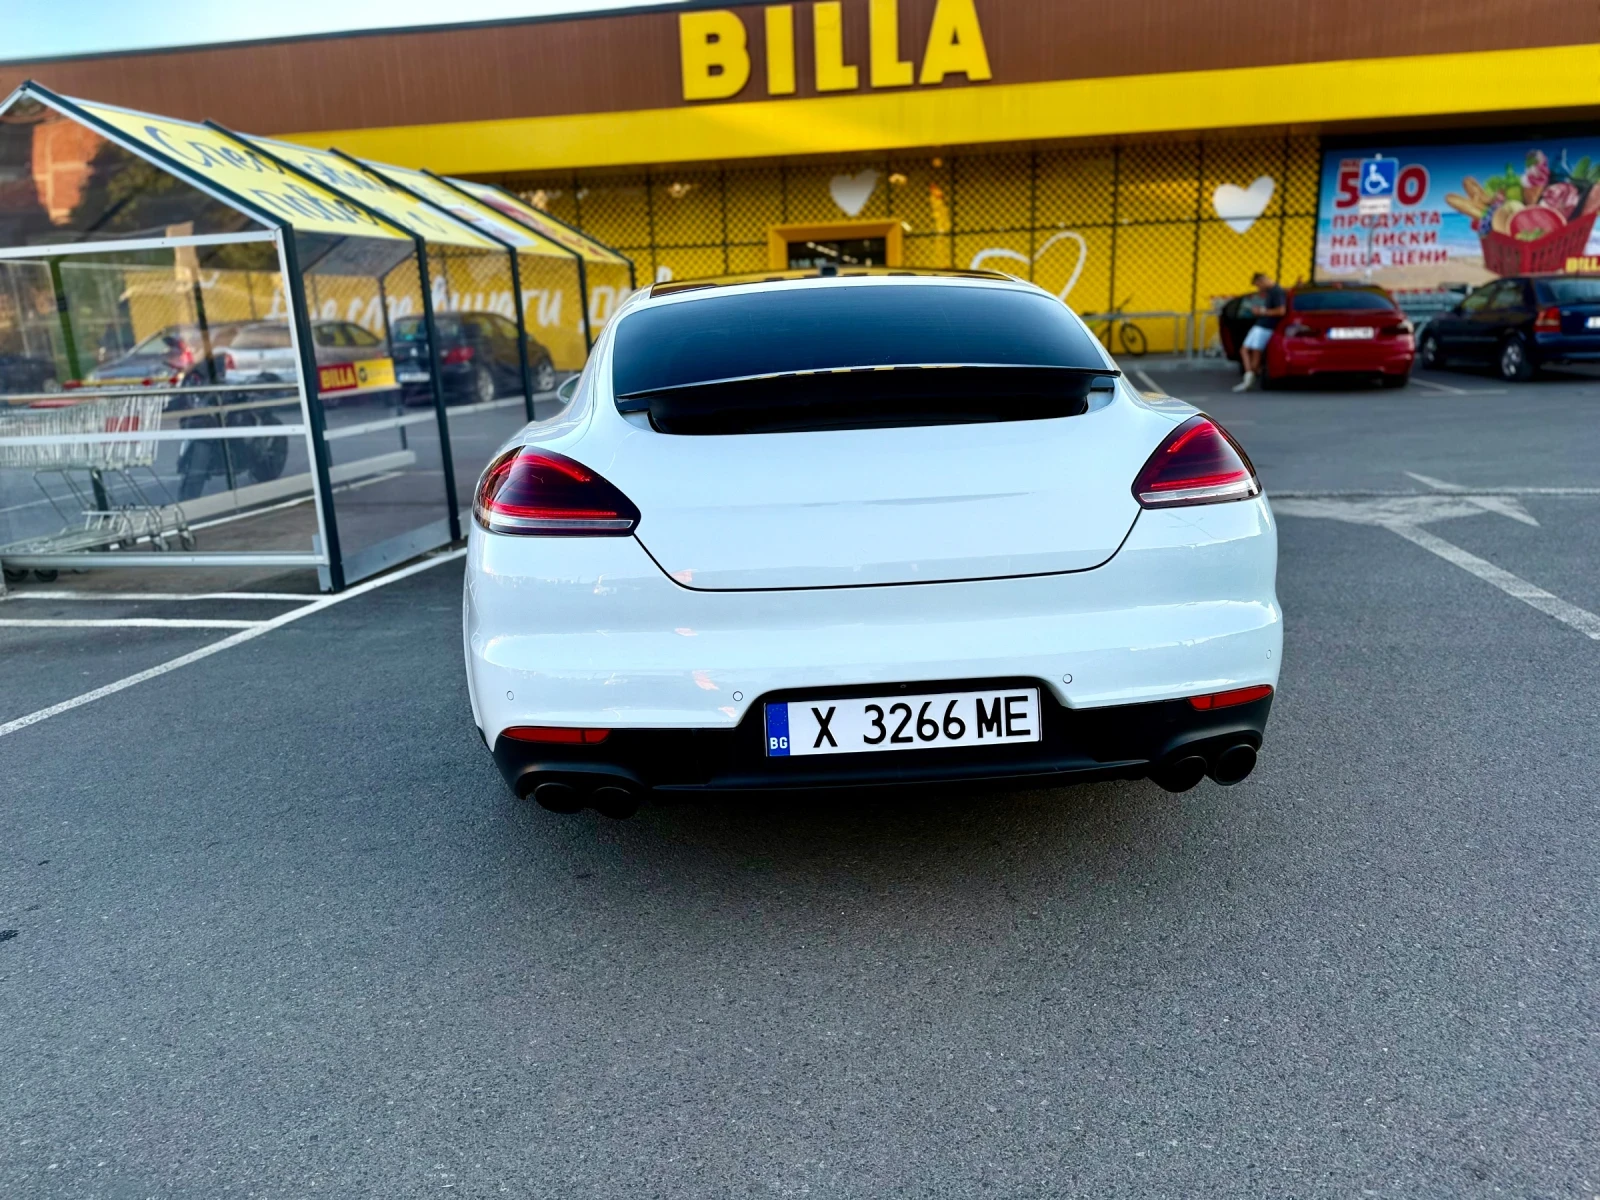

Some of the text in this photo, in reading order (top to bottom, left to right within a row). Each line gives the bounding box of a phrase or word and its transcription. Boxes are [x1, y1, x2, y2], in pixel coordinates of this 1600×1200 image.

[680, 0, 993, 101] BILLA
[1334, 165, 1429, 209] 50
[1333, 211, 1441, 229] ПРОДУКТА
[1331, 233, 1359, 248] НА
[1330, 249, 1448, 268] BILLA ЦЕНИ
[321, 367, 356, 389] BILLA
[769, 695, 1031, 750] BG X 3266 ME
